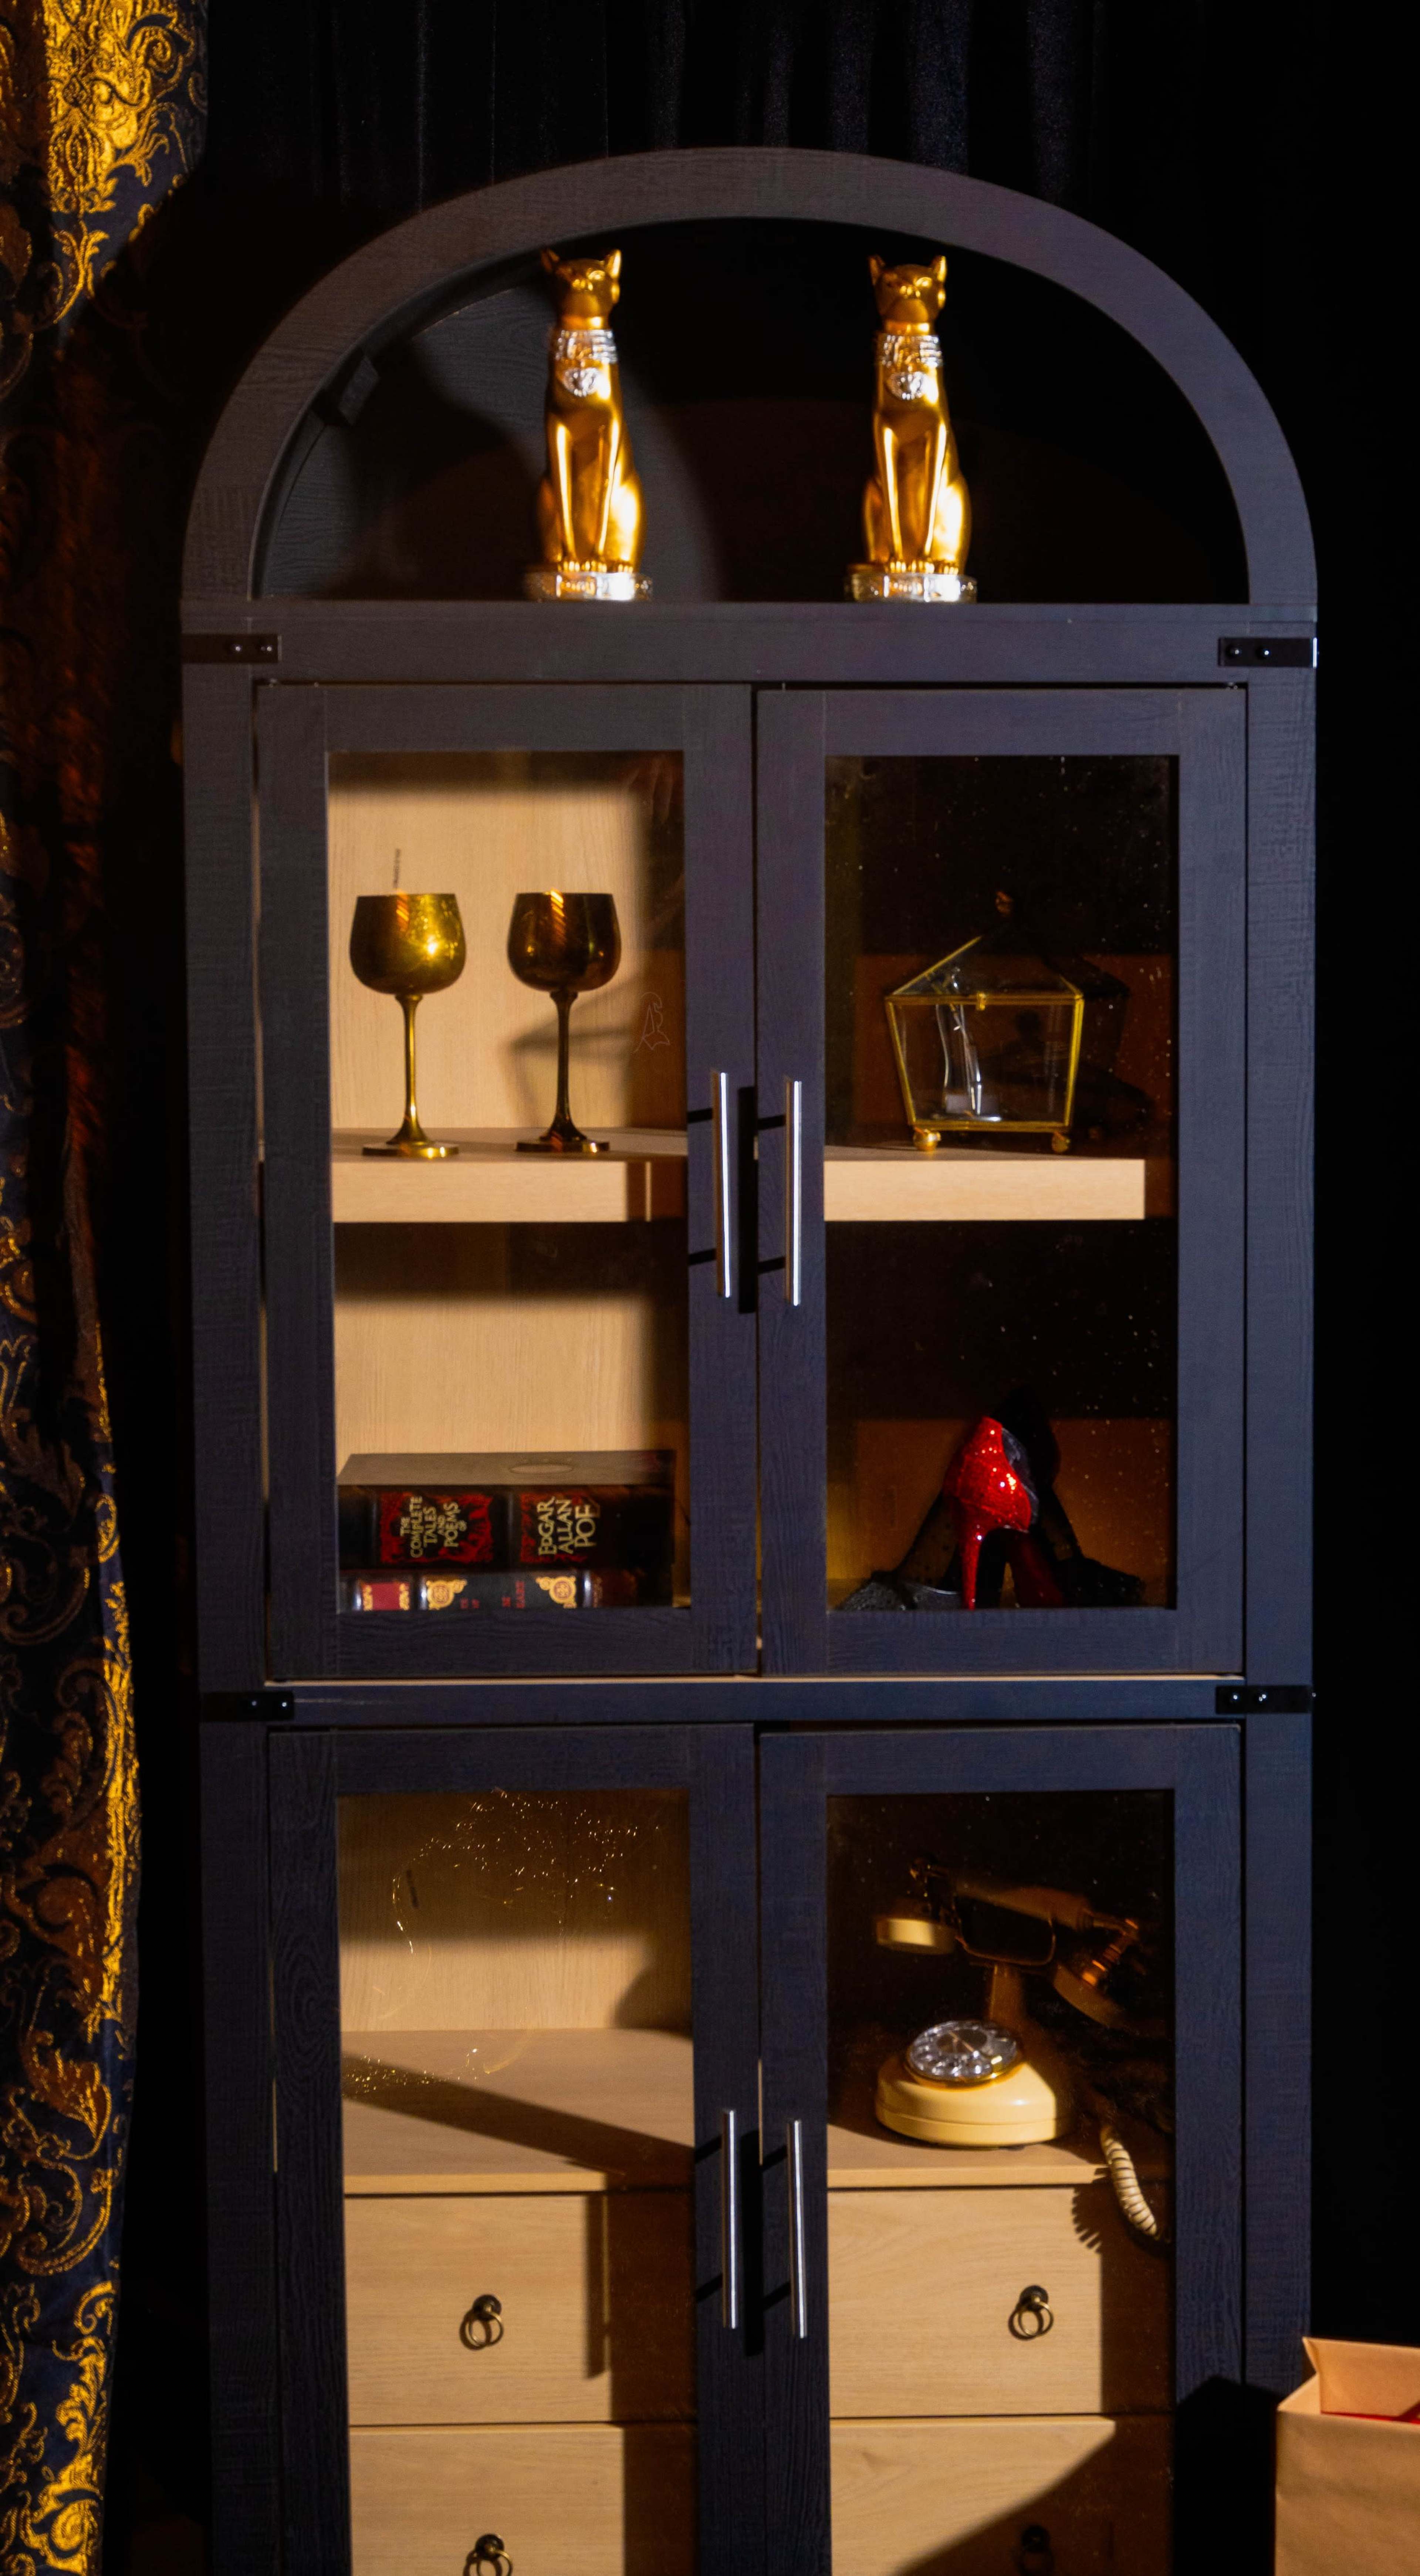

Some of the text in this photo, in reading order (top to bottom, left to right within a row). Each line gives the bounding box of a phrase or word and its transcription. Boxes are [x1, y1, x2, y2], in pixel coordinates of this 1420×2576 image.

[400, 1517, 410, 1537] THE
[409, 1496, 424, 1558] COMPLETE
[423, 1506, 438, 1547] TALES
[437, 1515, 446, 1536] AND
[443, 1502, 461, 1547] POEMS
[537, 1496, 557, 1555] EDGAR
[555, 1499, 574, 1554] ALLAN
[574, 1504, 600, 1548] POE
